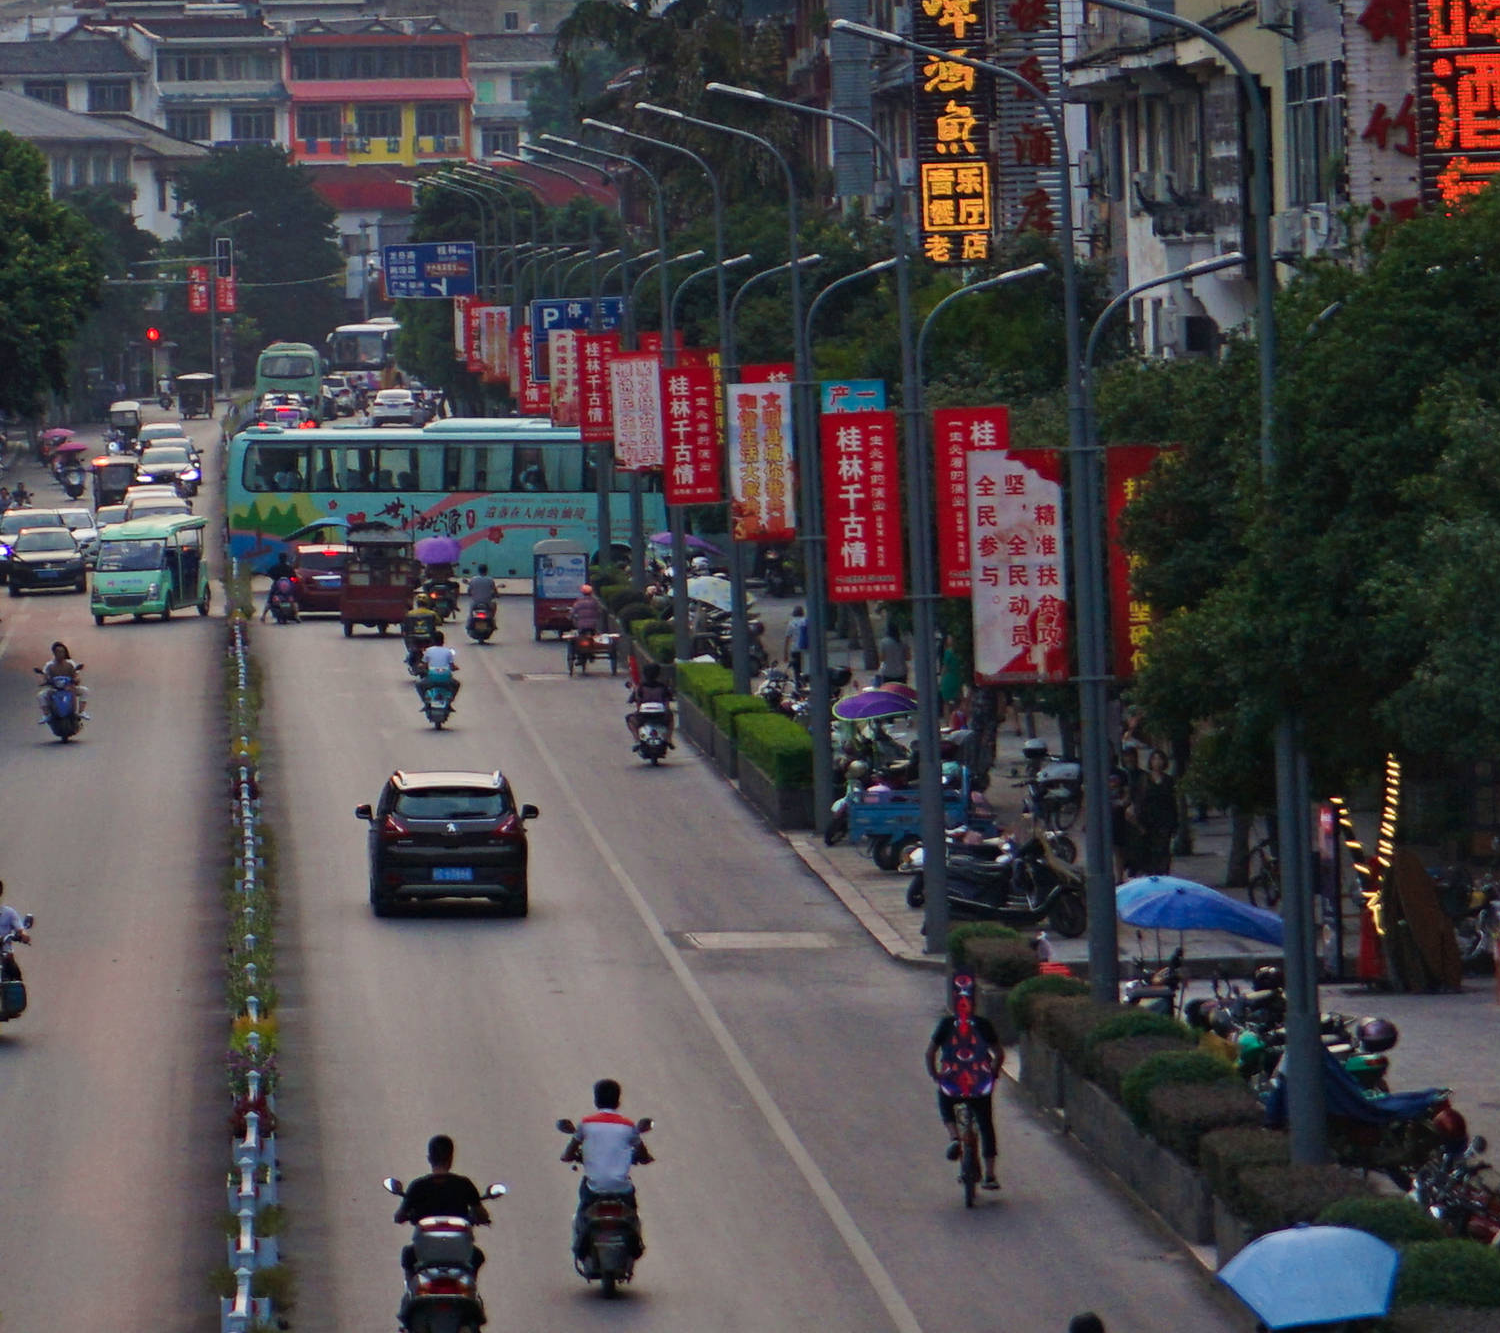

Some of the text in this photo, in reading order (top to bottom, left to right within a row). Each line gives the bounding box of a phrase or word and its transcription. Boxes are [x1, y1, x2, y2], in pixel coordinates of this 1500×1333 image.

[924, 233, 988, 261] 老店
[543, 308, 559, 329] P
[668, 375, 695, 485] 桂林千古情
[835, 425, 869, 569] 桂林千古情
[1033, 504, 1063, 647] 精准扶贫攻
